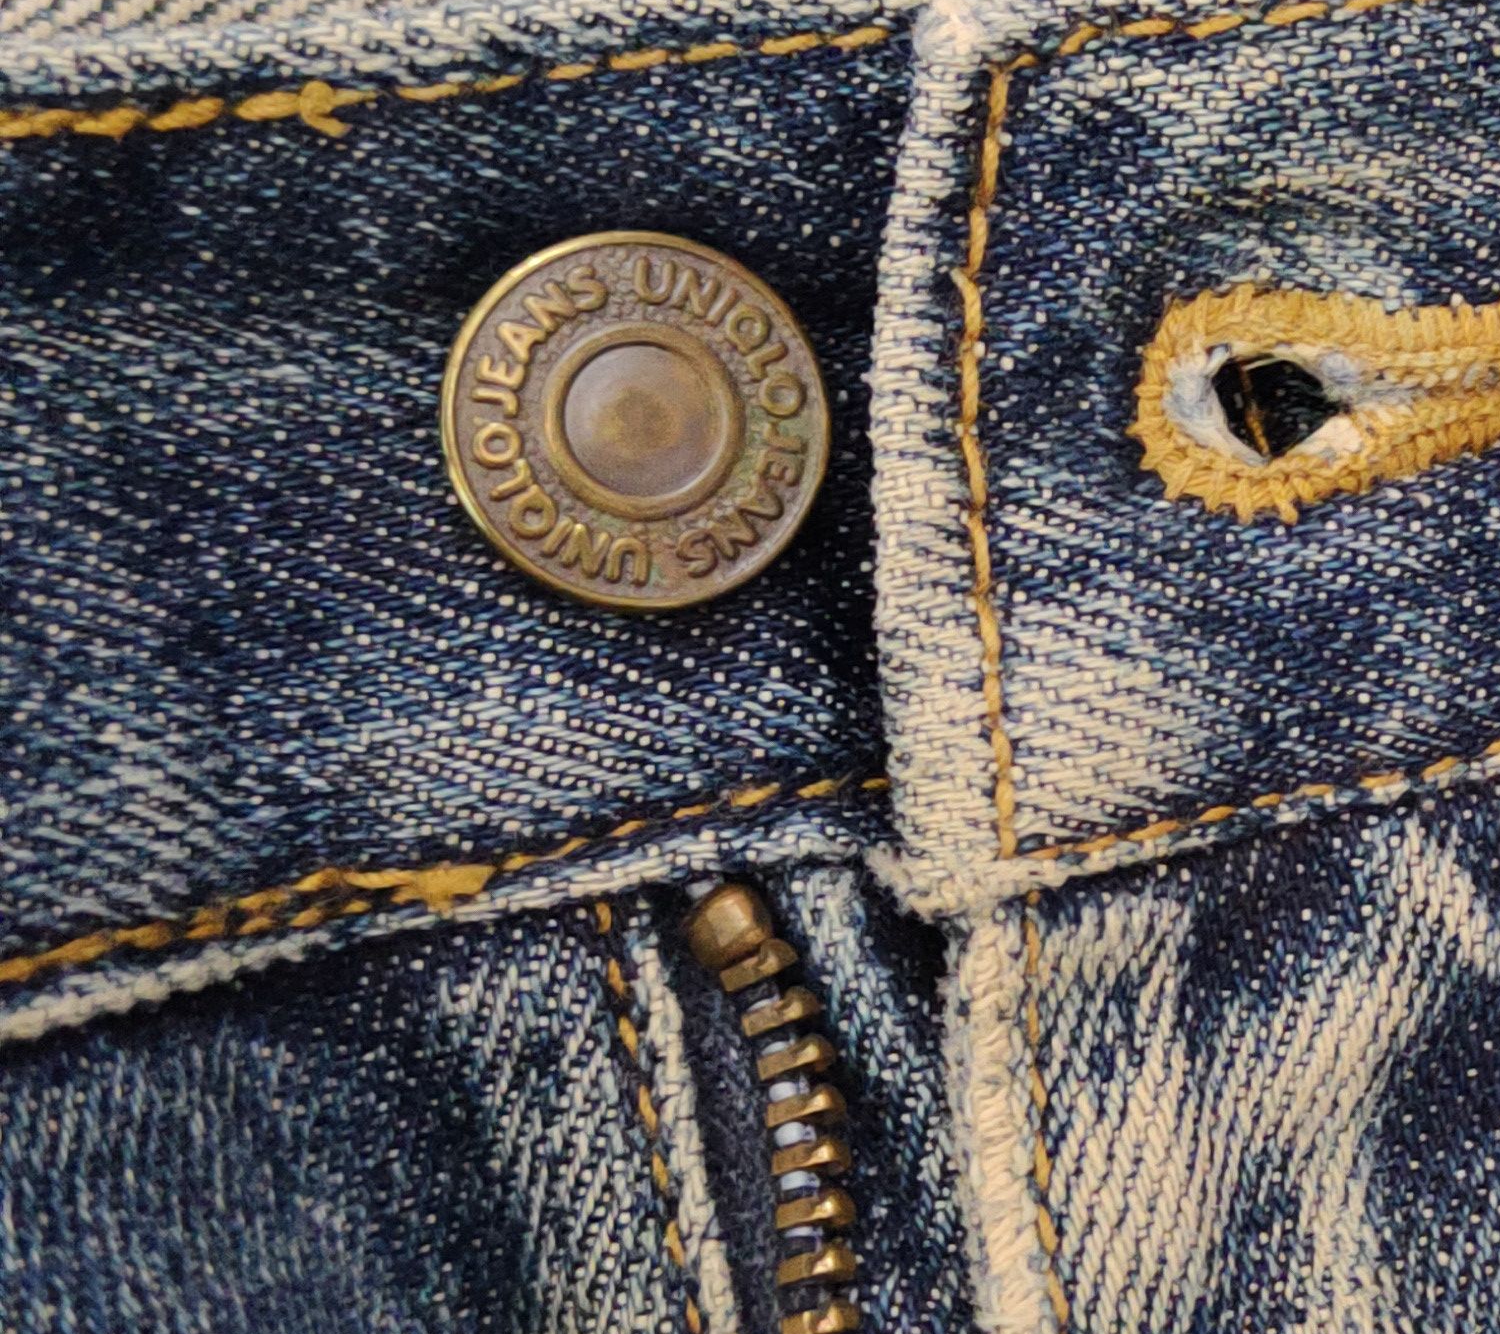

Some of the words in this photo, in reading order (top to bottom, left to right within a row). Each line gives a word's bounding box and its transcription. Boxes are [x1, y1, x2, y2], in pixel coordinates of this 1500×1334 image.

[472, 265, 608, 418] JEANS
[632, 257, 806, 417] UNIQLO
[473, 423, 652, 586] UNIQLO
[676, 421, 806, 578] JEANS
